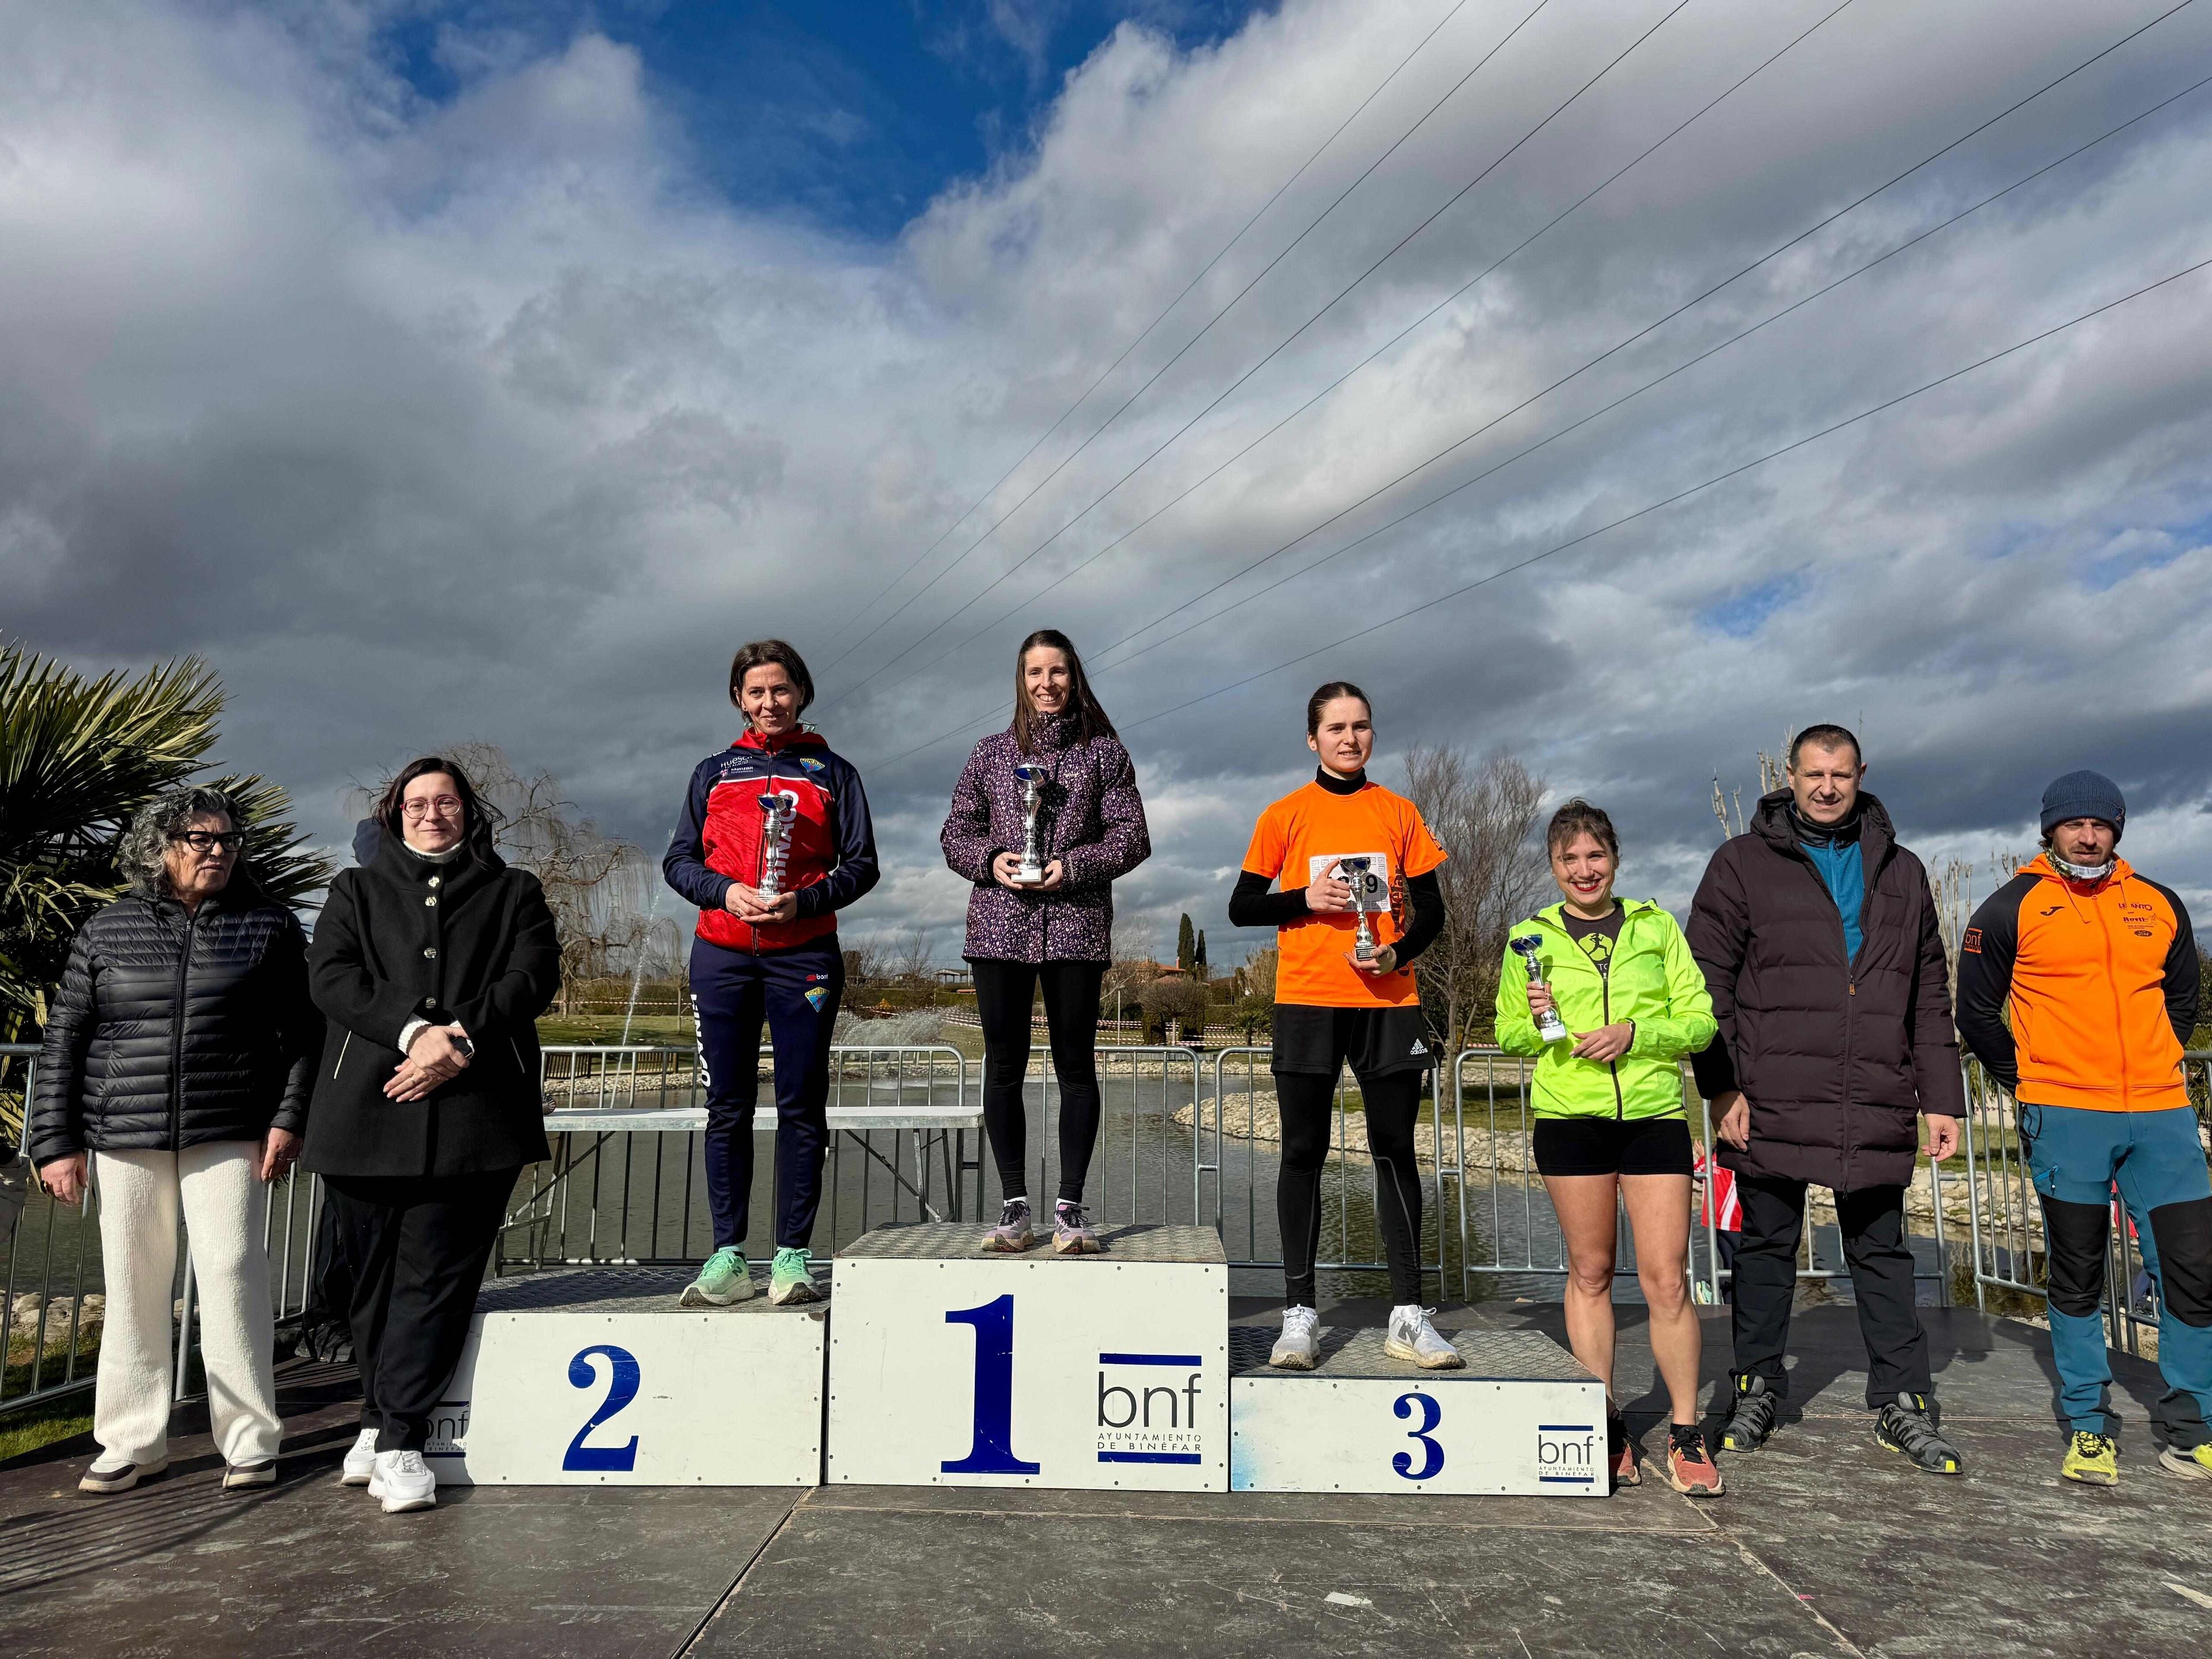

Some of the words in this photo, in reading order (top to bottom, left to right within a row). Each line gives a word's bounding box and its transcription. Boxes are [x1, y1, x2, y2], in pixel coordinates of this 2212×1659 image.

[562, 1345, 641, 1471] 2
[941, 1294, 1041, 1475] 1
[1098, 1371, 1201, 1429] bnf
[1098, 1432, 1202, 1442] AYUNTAMIENTO
[1129, 1442, 1202, 1452] BINÉFAR
[1392, 1393, 1444, 1480] 3
[1538, 1434, 1594, 1464] bnf
